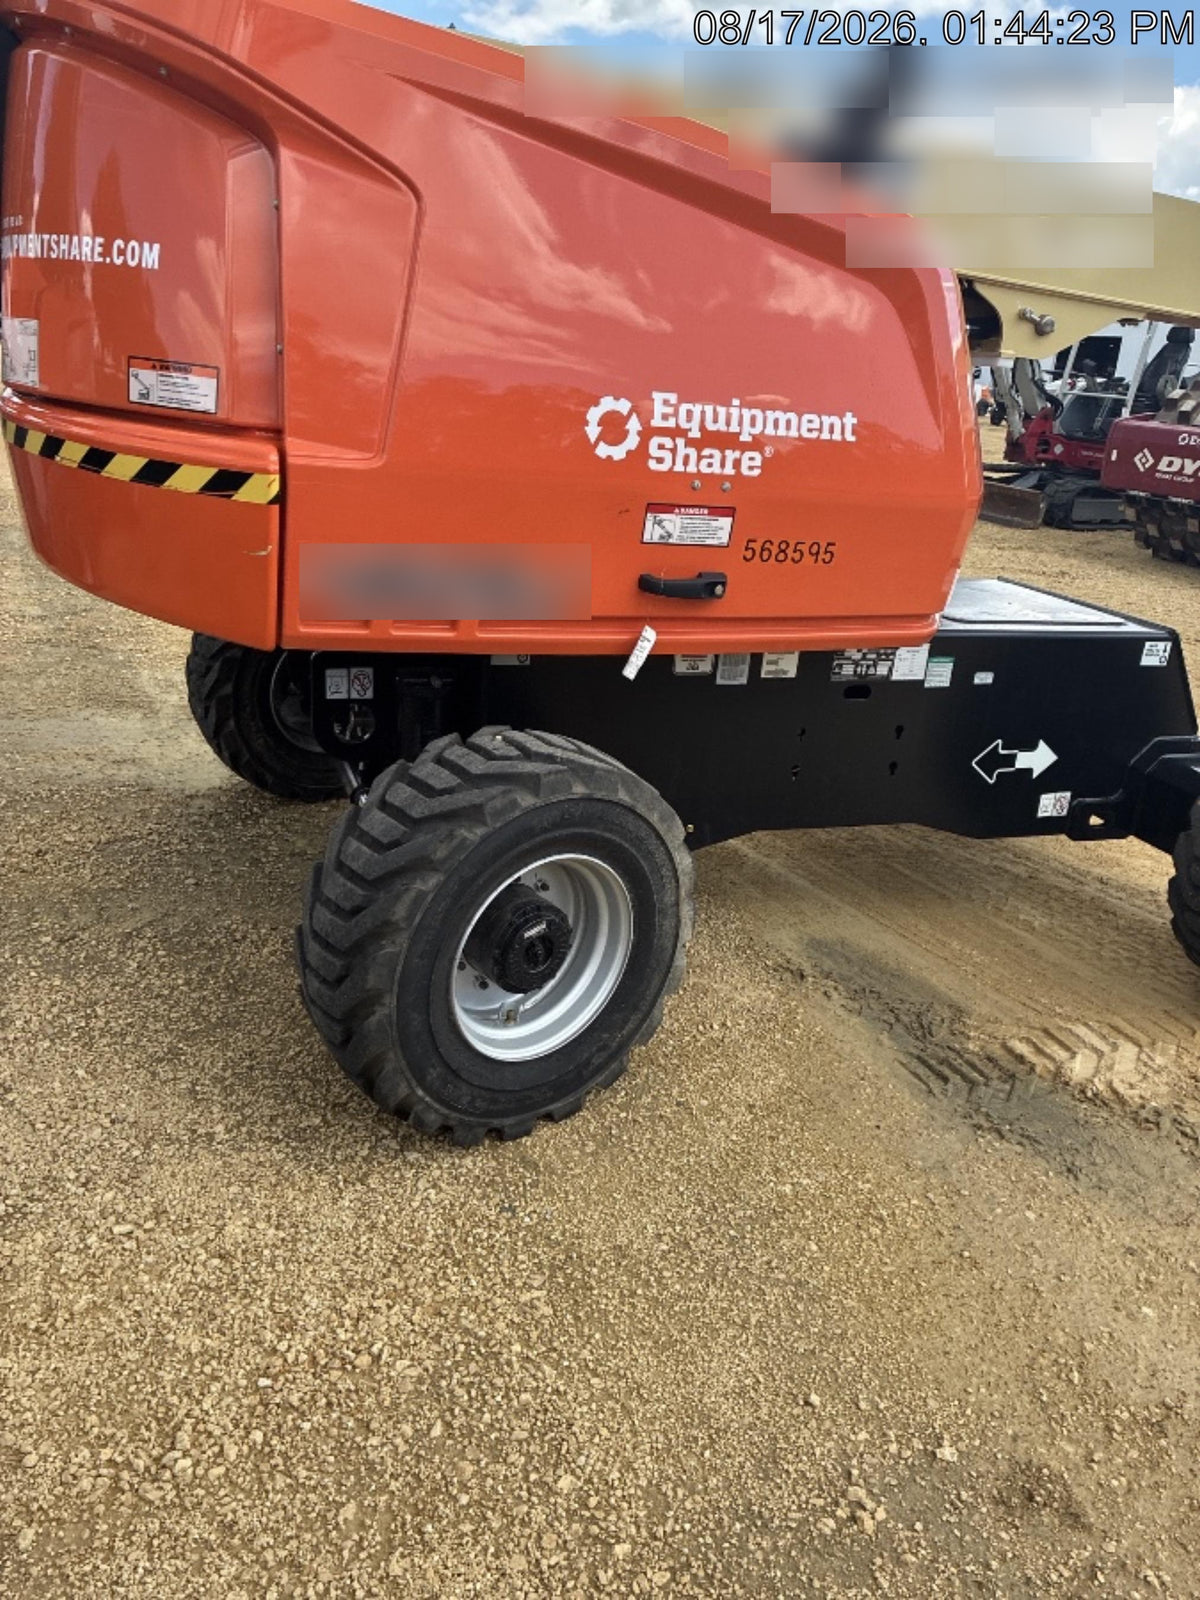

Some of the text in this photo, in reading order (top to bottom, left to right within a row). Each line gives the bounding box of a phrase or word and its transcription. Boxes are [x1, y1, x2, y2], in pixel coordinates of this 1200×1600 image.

[650, 391, 858, 442] Equipment
[648, 435, 762, 477] Share
[1156, 456, 1200, 477] DY
[742, 538, 836, 565] 568595
